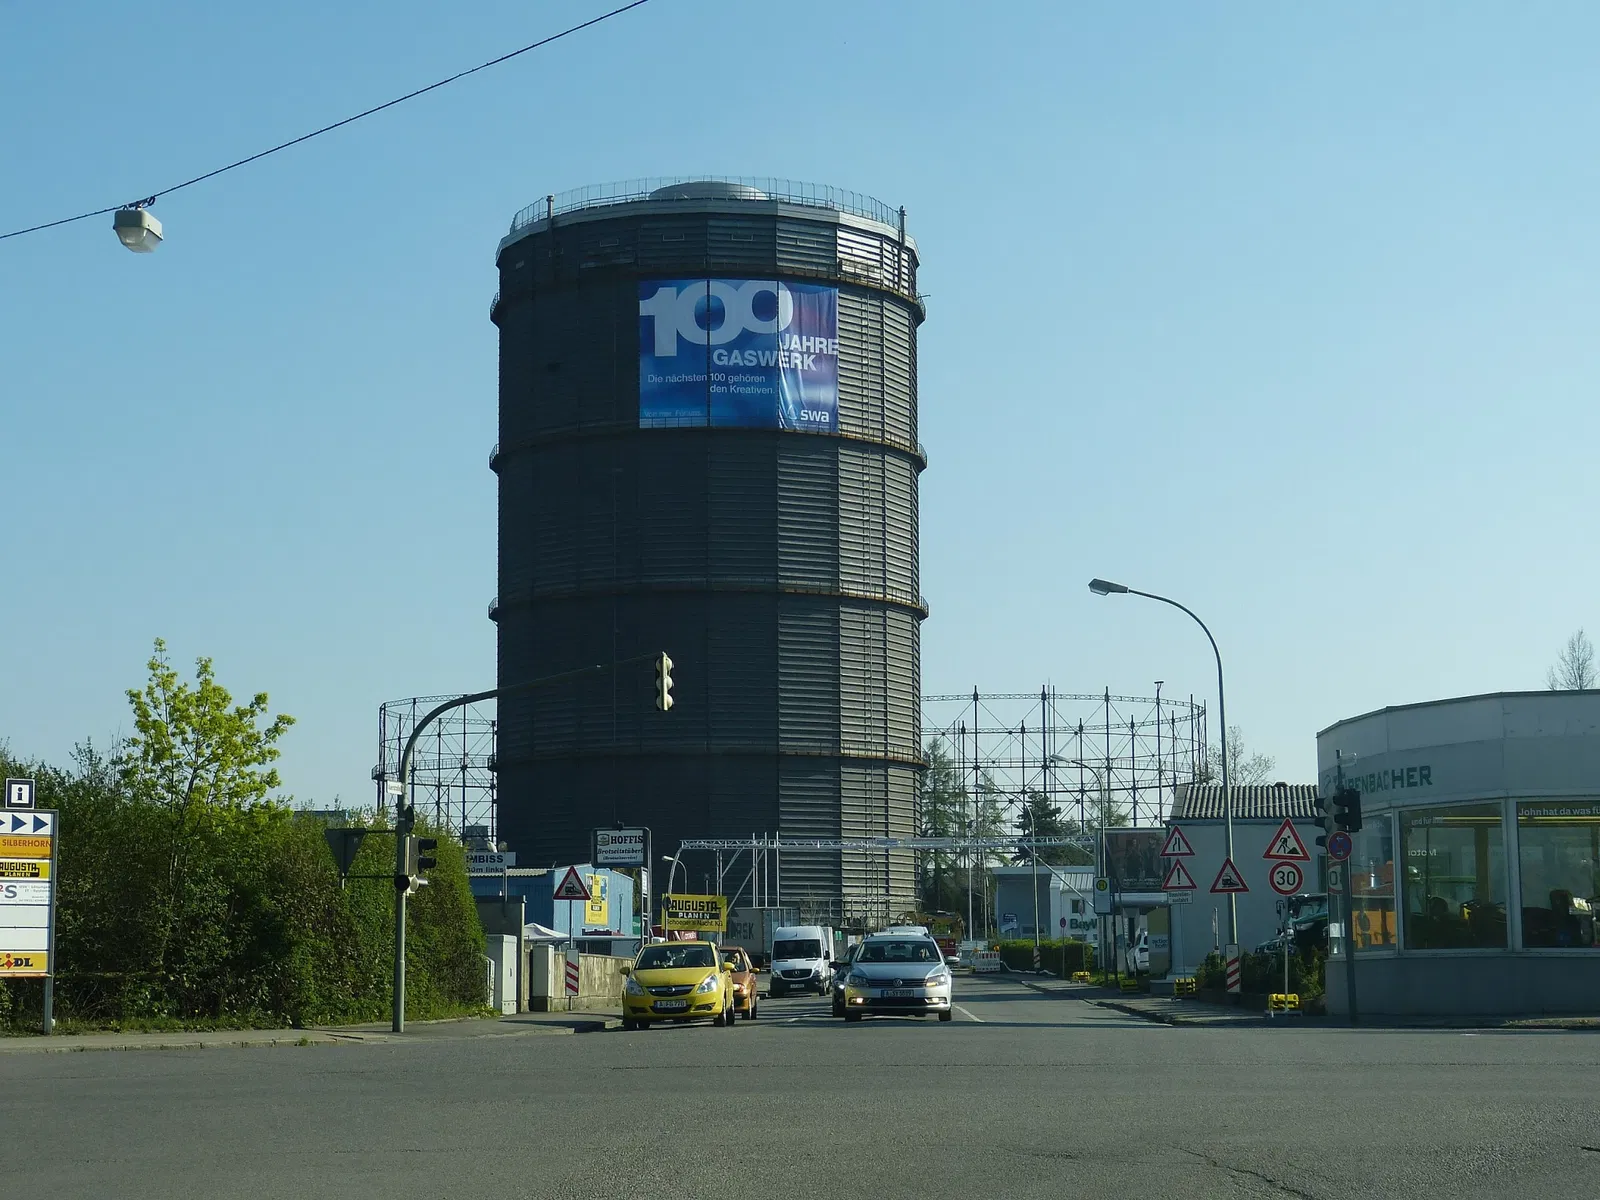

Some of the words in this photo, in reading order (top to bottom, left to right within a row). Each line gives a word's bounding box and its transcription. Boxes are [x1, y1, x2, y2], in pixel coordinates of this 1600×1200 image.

[640, 280, 793, 356] 100
[783, 334, 838, 356] JAHRE
[713, 349, 817, 371] GASWERK
[648, 374, 663, 383] Die
[665, 373, 707, 383] nächsten
[710, 373, 725, 382] 100
[728, 374, 766, 384] gehören
[710, 384, 727, 394] den
[730, 385, 775, 395] Kreativen.
[800, 409, 830, 423] swa
[1518, 808, 1541, 816] John
[1543, 808, 1557, 816] hat
[1560, 808, 1571, 816] da
[2, 839, 51, 848] SILBERHORN
[611, 835, 644, 845] HOFFIS
[0, 862, 38, 872] AUGUSTA
[1276, 871, 1296, 885] 30
[671, 900, 719, 911] AUGUSTA
